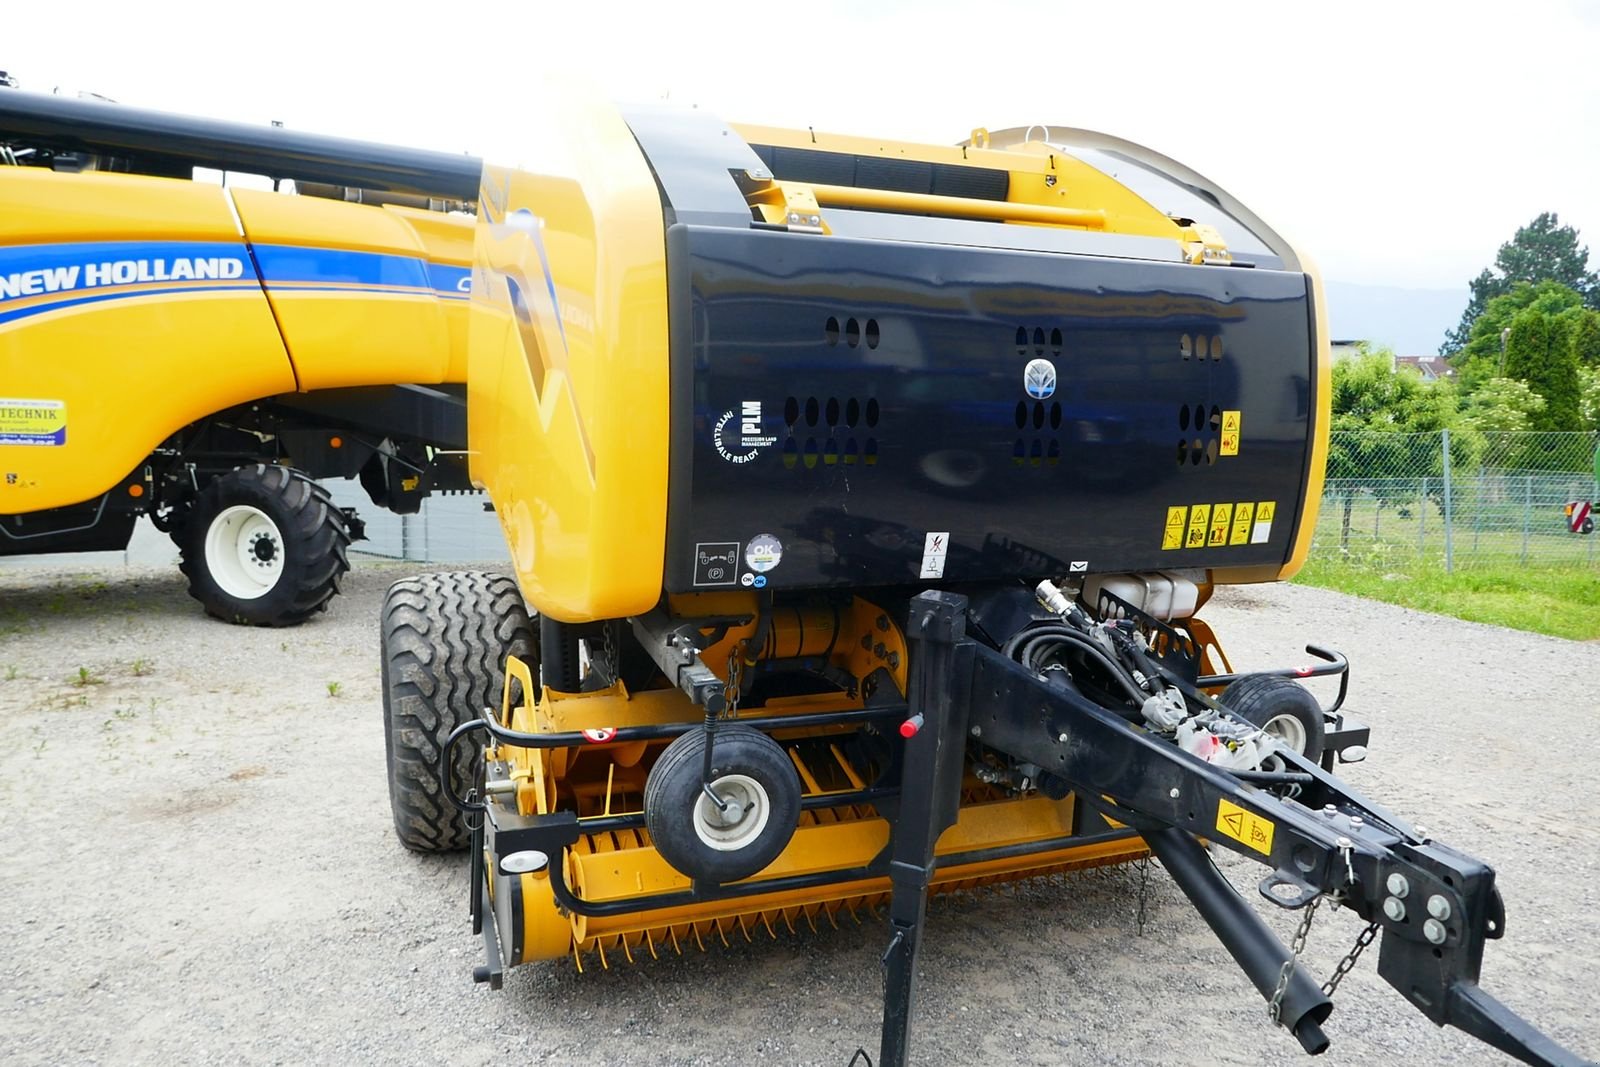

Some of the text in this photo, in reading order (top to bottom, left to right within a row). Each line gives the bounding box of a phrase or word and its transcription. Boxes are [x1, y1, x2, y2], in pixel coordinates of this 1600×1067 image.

[0, 258, 243, 299] NEW HOLLAND
[741, 401, 761, 434] PLM
[732, 448, 759, 464] READY
[754, 545, 774, 555] OK
